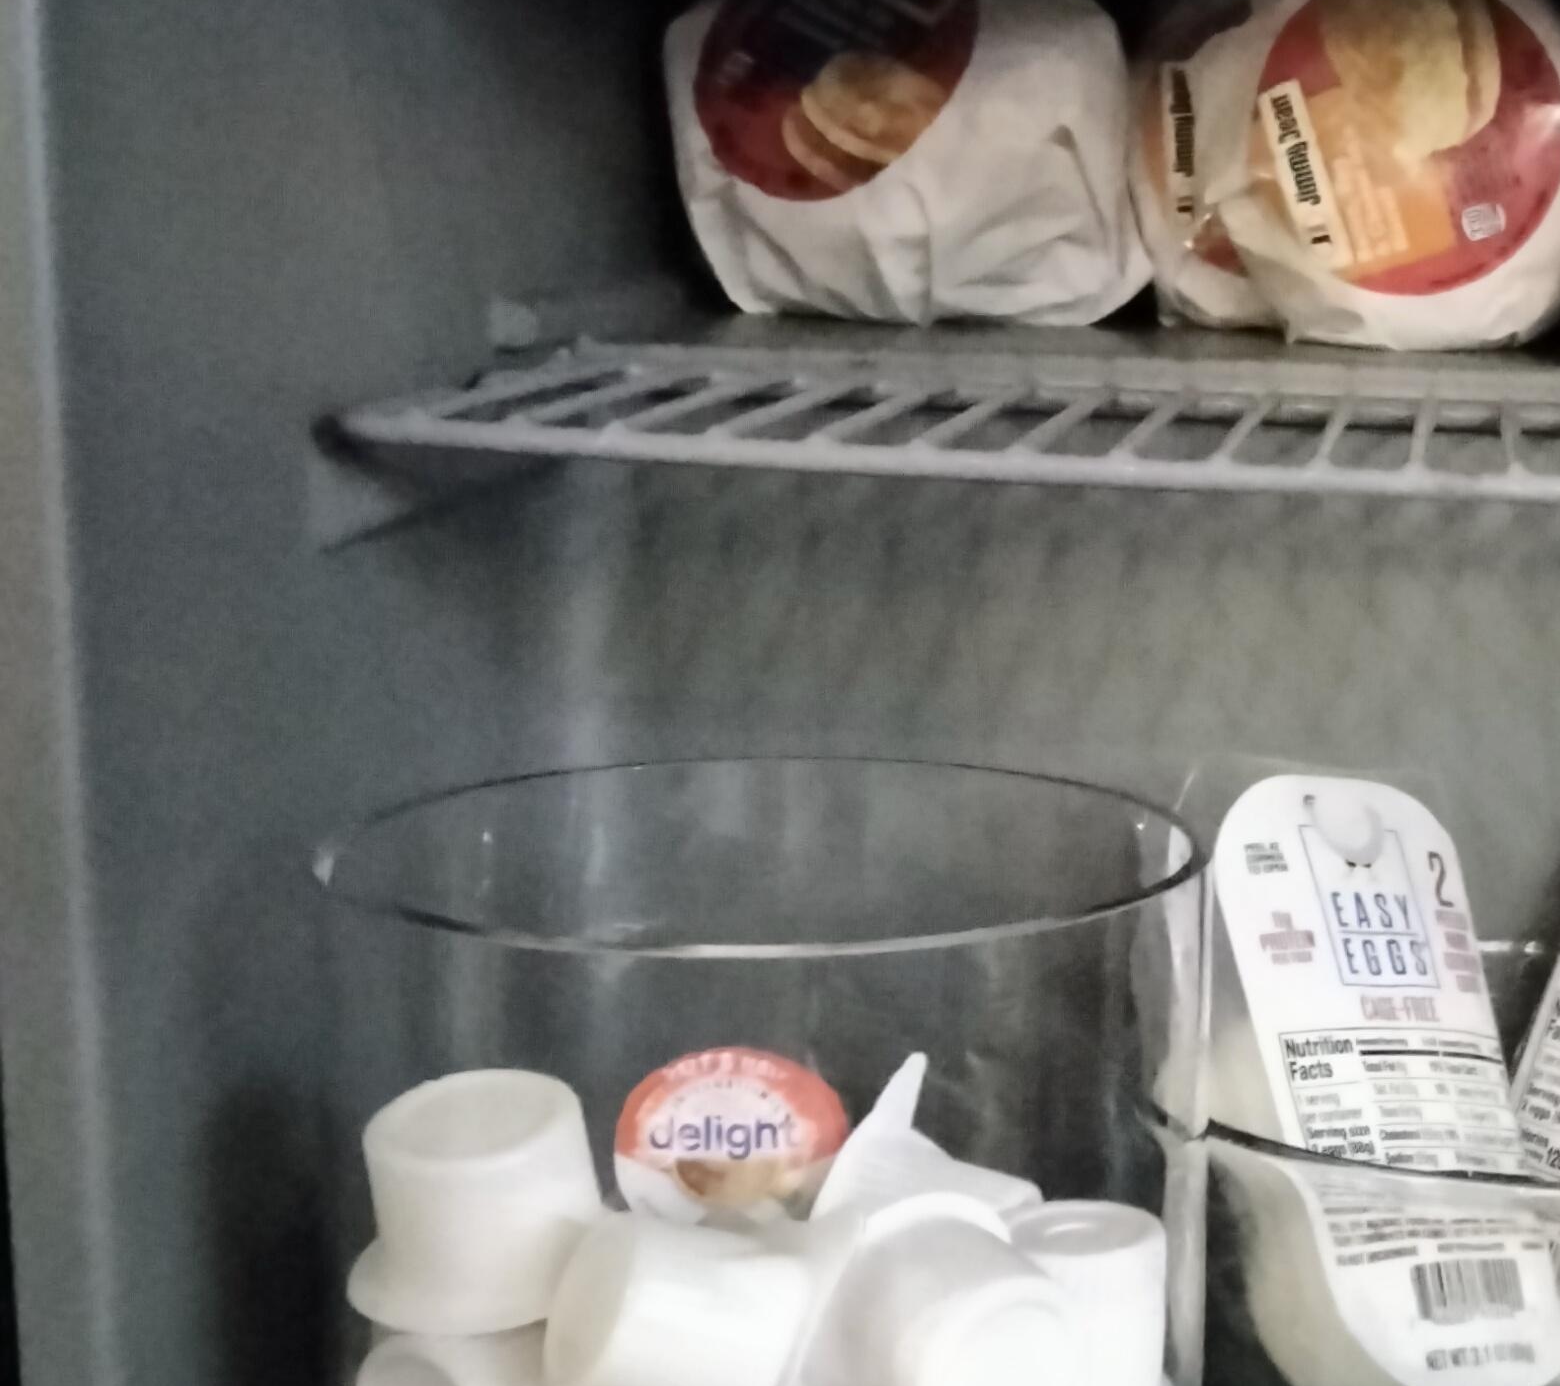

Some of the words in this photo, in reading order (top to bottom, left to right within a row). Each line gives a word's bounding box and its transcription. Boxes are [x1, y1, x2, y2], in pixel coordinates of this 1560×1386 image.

[1427, 850, 1456, 909] 2
[1330, 891, 1411, 930] EASY
[1341, 937, 1429, 976] EGGS
[1284, 1036, 1353, 1060] Nutrition
[1288, 1061, 1334, 1082] Facts
[649, 1115, 802, 1161] delight
